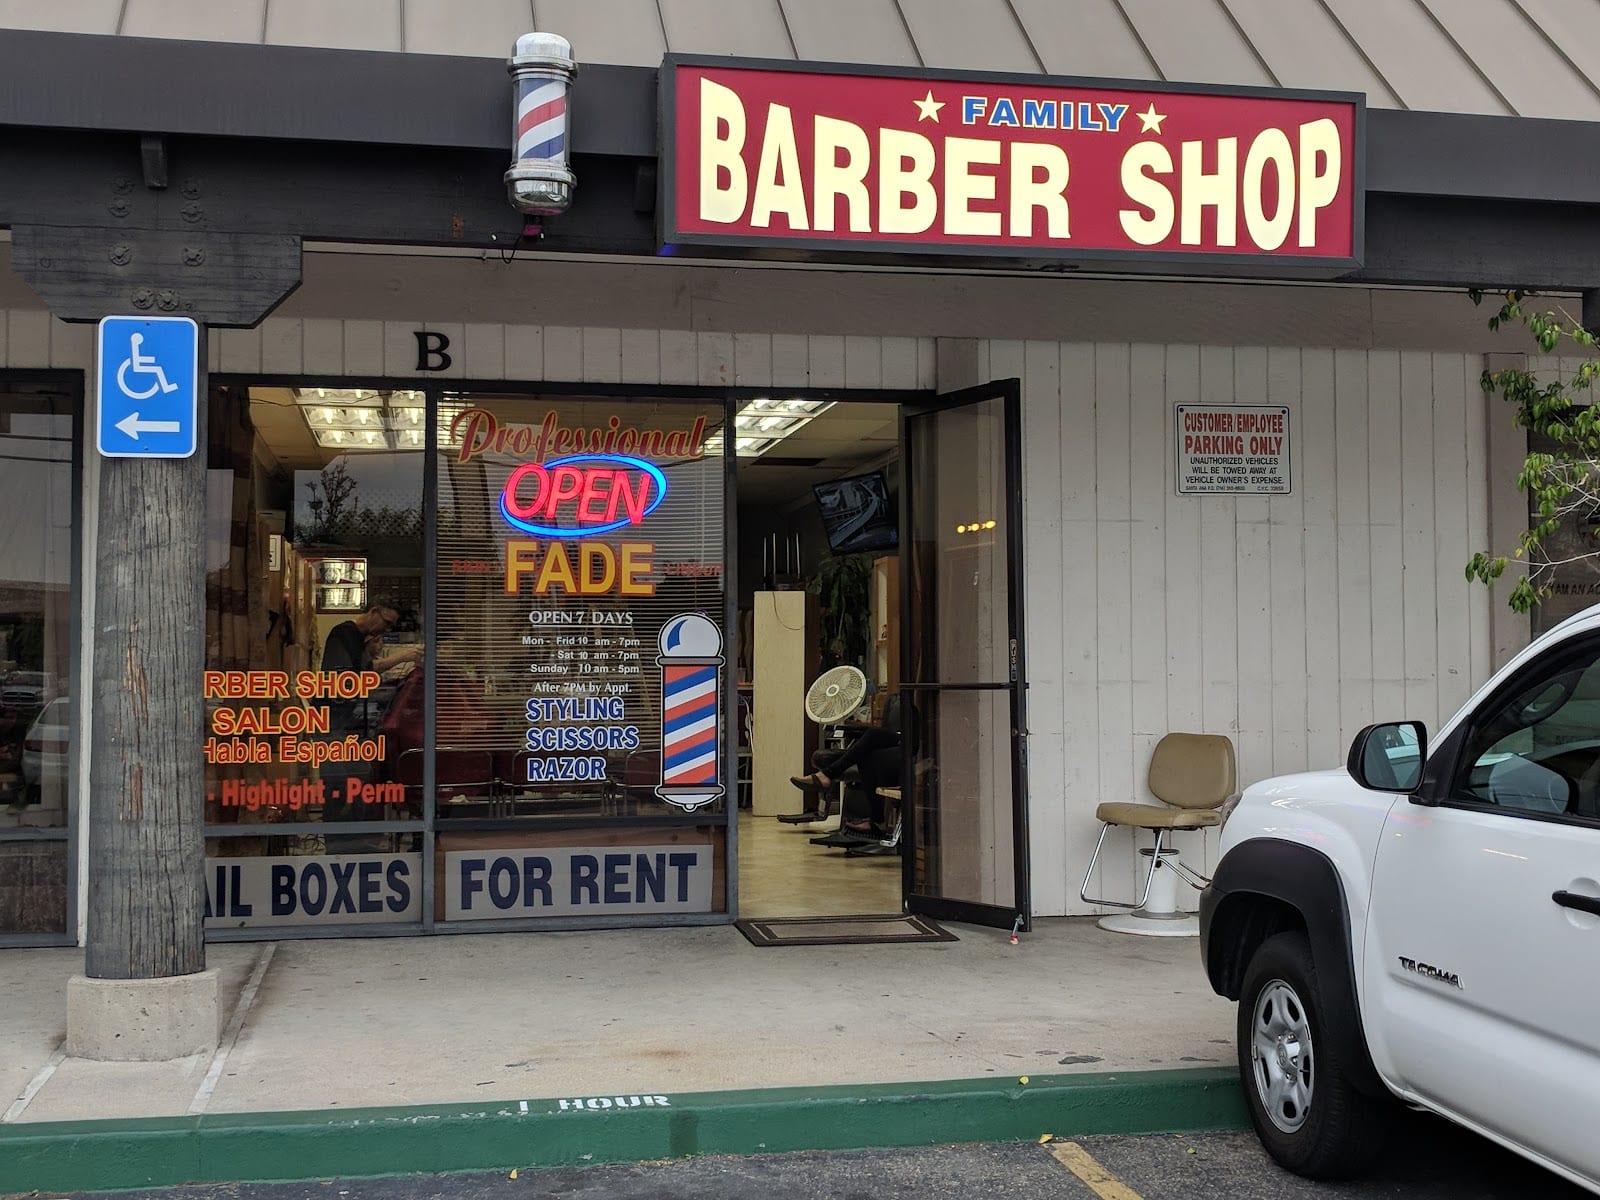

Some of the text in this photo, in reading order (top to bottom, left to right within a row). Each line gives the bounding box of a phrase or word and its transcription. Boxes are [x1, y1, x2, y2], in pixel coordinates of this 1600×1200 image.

[961, 95, 1130, 133] FAMILY
[699, 76, 1343, 252] BARBER SHOP
[413, 331, 452, 372] B
[450, 408, 707, 464] Professional
[1184, 435, 1283, 456] PARKING ONLY
[1190, 457, 1279, 466] UNAUTHORIZED VEHICLES
[1191, 466, 1278, 475] WILL BE TOWED AWAY AT
[503, 462, 652, 525] OPEN
[1185, 476, 1214, 484] VEHICLE
[1216, 476, 1249, 484] OWNER'S
[503, 538, 657, 597] FADE
[529, 610, 634, 625] OPEN 7 DAYS
[522, 636, 544, 645] Mon
[556, 636, 575, 645] Frid
[578, 636, 588, 645] 10
[595, 638, 610, 646] am
[619, 637, 640, 647] 7pm
[530, 664, 568, 675] Sunday
[579, 663, 591, 673] 10
[594, 665, 608, 673] am
[618, 664, 640, 675] 5pm
[557, 650, 574, 660] Sat
[579, 651, 588, 660] 10
[593, 652, 608, 660] am
[618, 650, 640, 661] 7pm
[204, 671, 380, 698] RBER SHOP
[534, 681, 633, 695] After 7PM by Appt.
[212, 706, 330, 735] SALON
[526, 696, 625, 721] STYLING
[279, 735, 386, 769] Español
[526, 725, 640, 752] SCISSORS
[527, 756, 607, 782] RAZOR
[221, 777, 406, 812] Highlight Perm
[204, 859, 411, 918] IL BOXES
[460, 852, 698, 911] FOR RENT
[1398, 956, 1465, 990] TACOMA
[558, 1094, 673, 1111] HOUR
